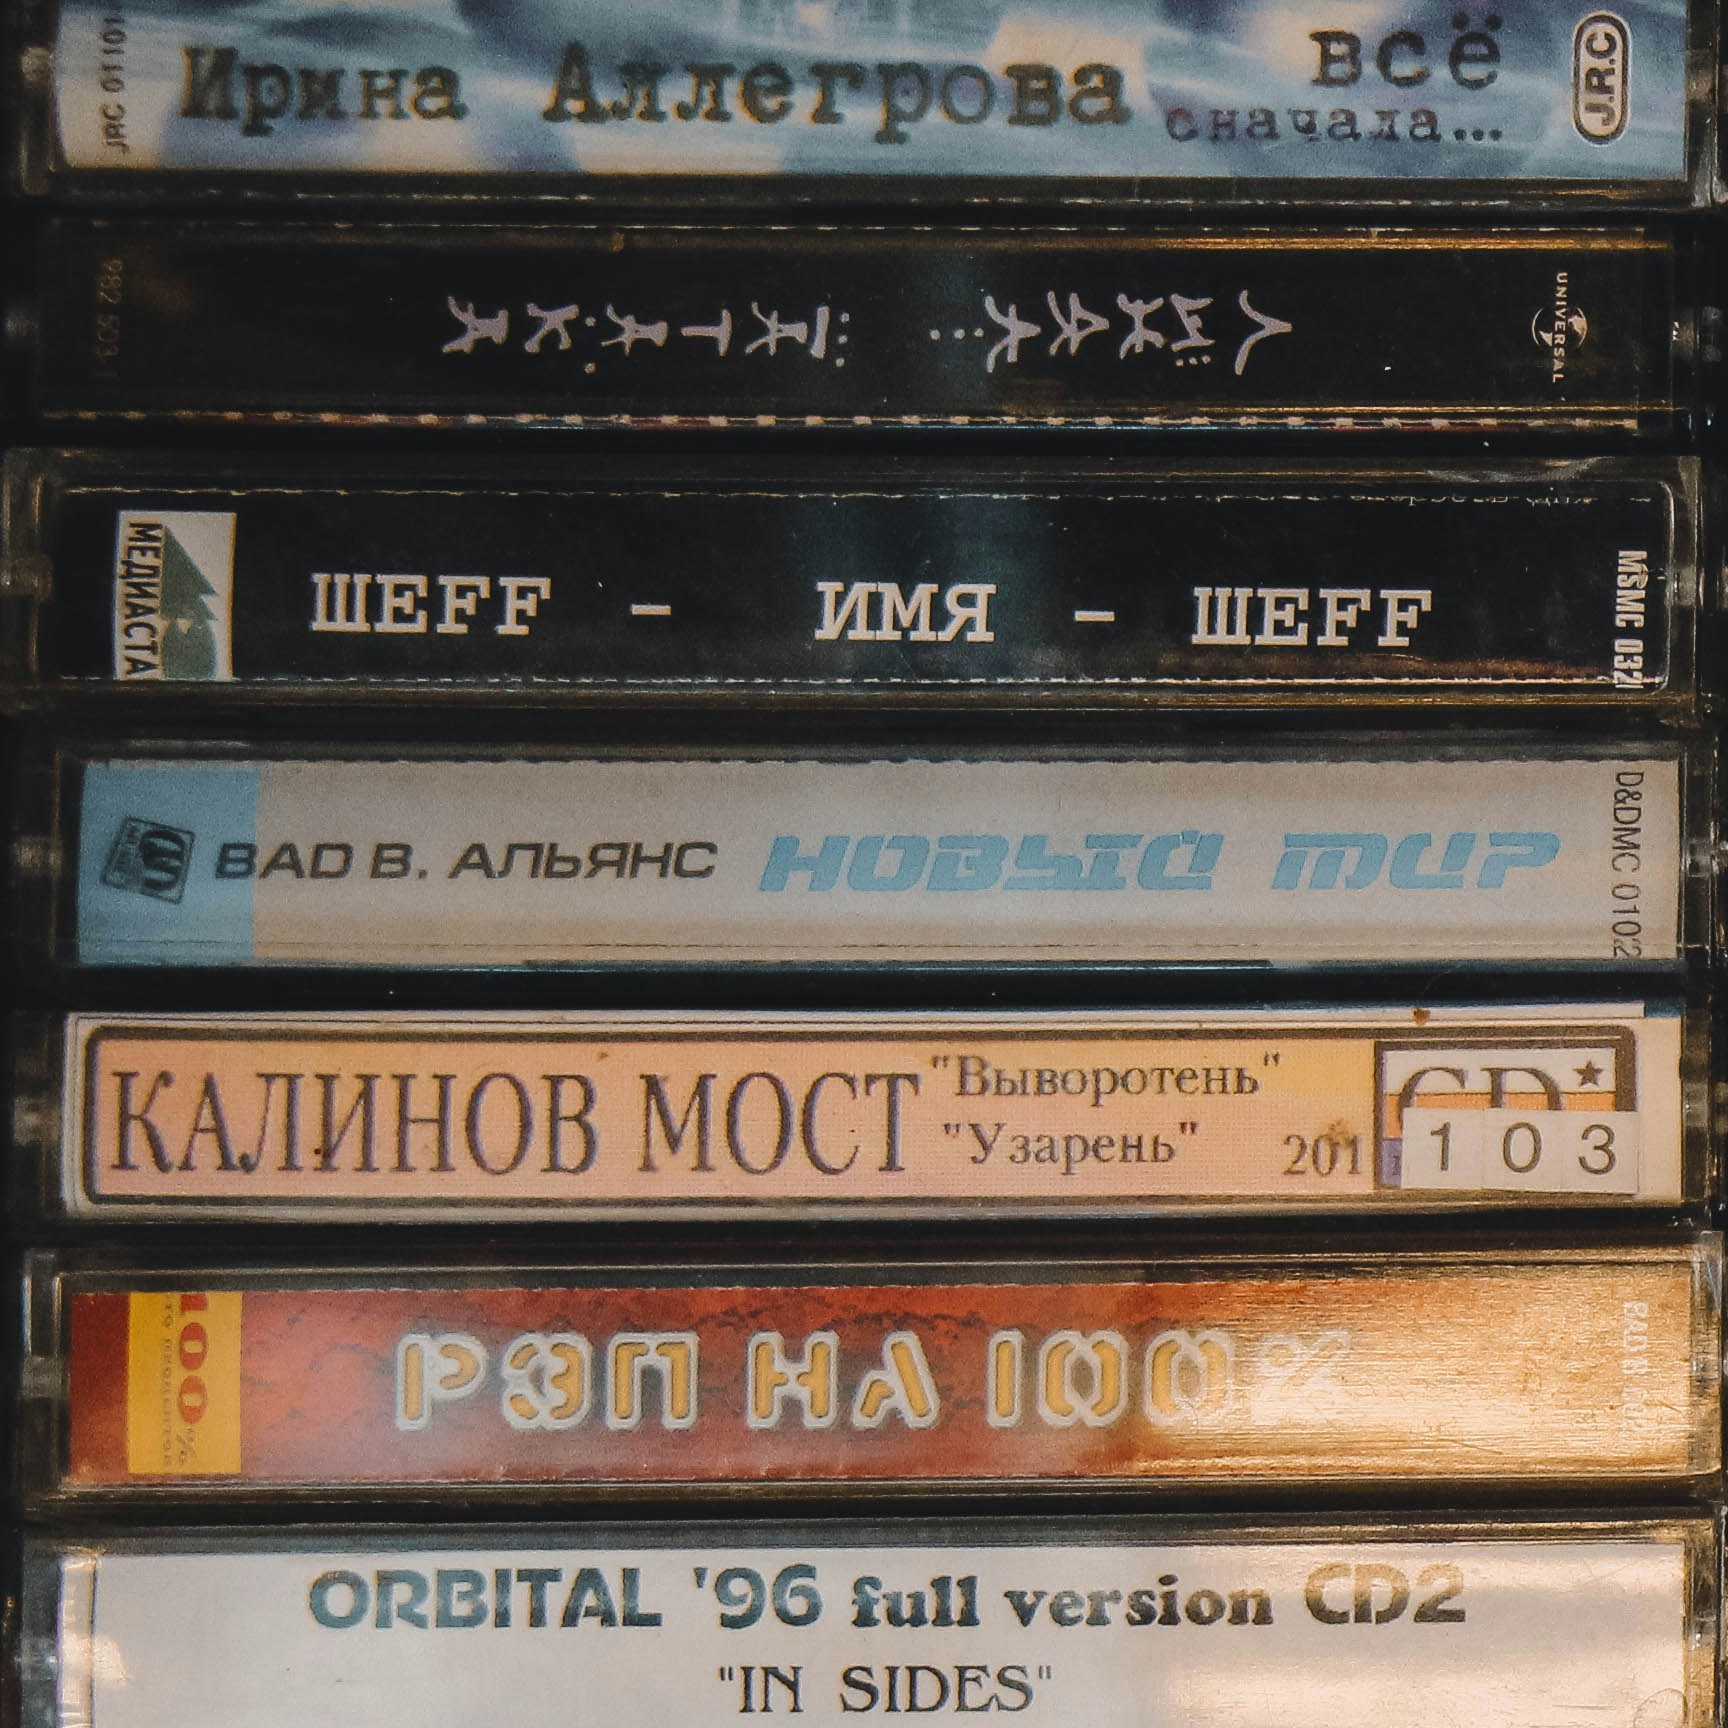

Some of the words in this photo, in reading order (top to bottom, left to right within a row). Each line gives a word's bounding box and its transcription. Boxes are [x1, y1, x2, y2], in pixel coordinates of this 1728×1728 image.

[1310, 13, 1502, 90] всё
[181, 46, 468, 136] Ирина
[543, 41, 1130, 146] Аллегрова
[1552, 272, 1568, 384] UNIVERSAL
[814, 581, 996, 643] ИМЯ
[214, 842, 354, 881] BAD
[450, 841, 719, 880] АЛЬЯНС
[931, 1051, 1280, 1107] "Выворотень"
[112, 1069, 597, 1175] КАЛИНОВ
[638, 1071, 920, 1176] МОСТ
[943, 1121, 1198, 1179] "Узарень"
[309, 1566, 662, 1630] ORBITAL
[692, 1563, 823, 1629] '96
[852, 1573, 980, 1628] full
[1004, 1574, 1273, 1627] version
[1303, 1563, 1467, 1626] CD2
